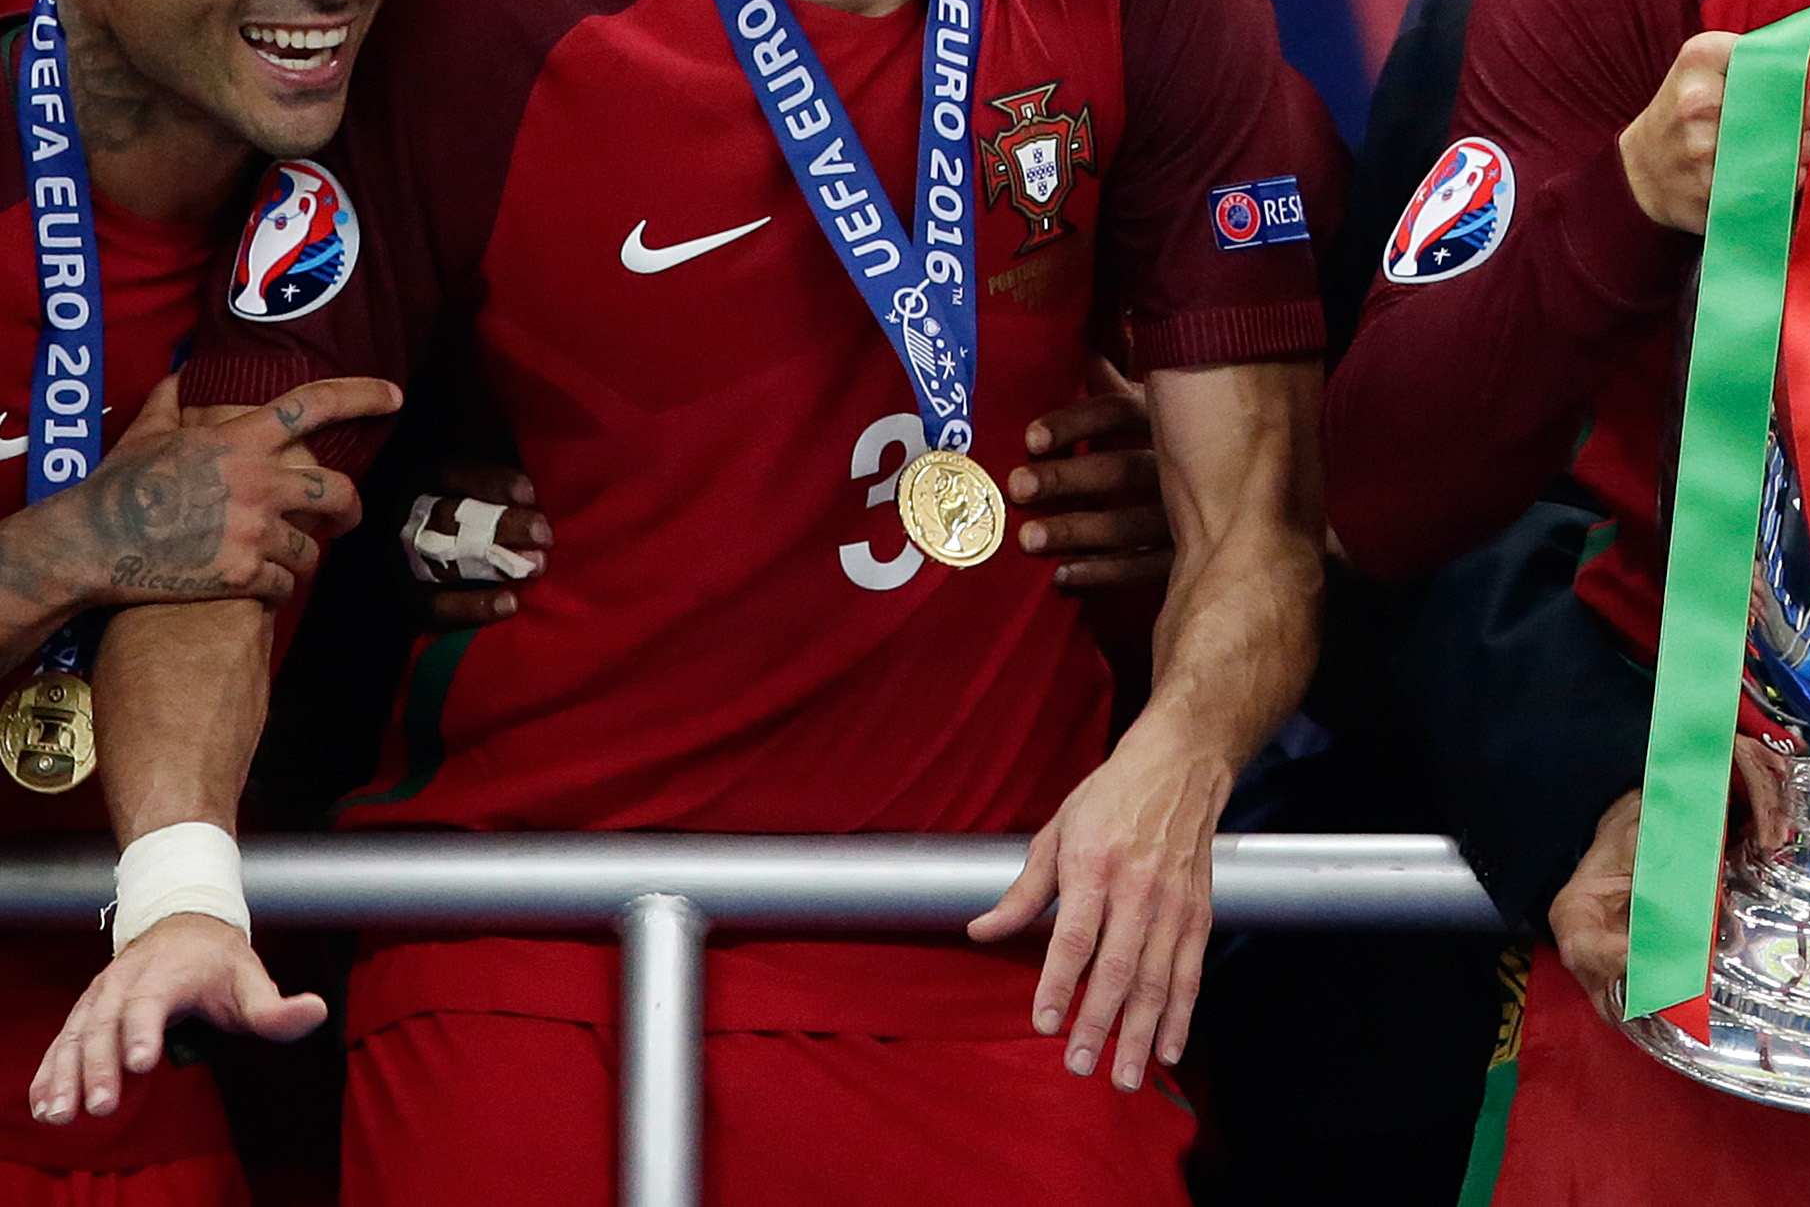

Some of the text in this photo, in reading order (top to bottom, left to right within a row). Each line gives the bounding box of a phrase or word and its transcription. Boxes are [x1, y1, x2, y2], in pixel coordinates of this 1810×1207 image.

[30, 13, 92, 485] UEFA EURO 2016
[808, 137, 902, 280] UEFA
[1222, 195, 1249, 209] UEFA
[838, 412, 928, 592] 3
